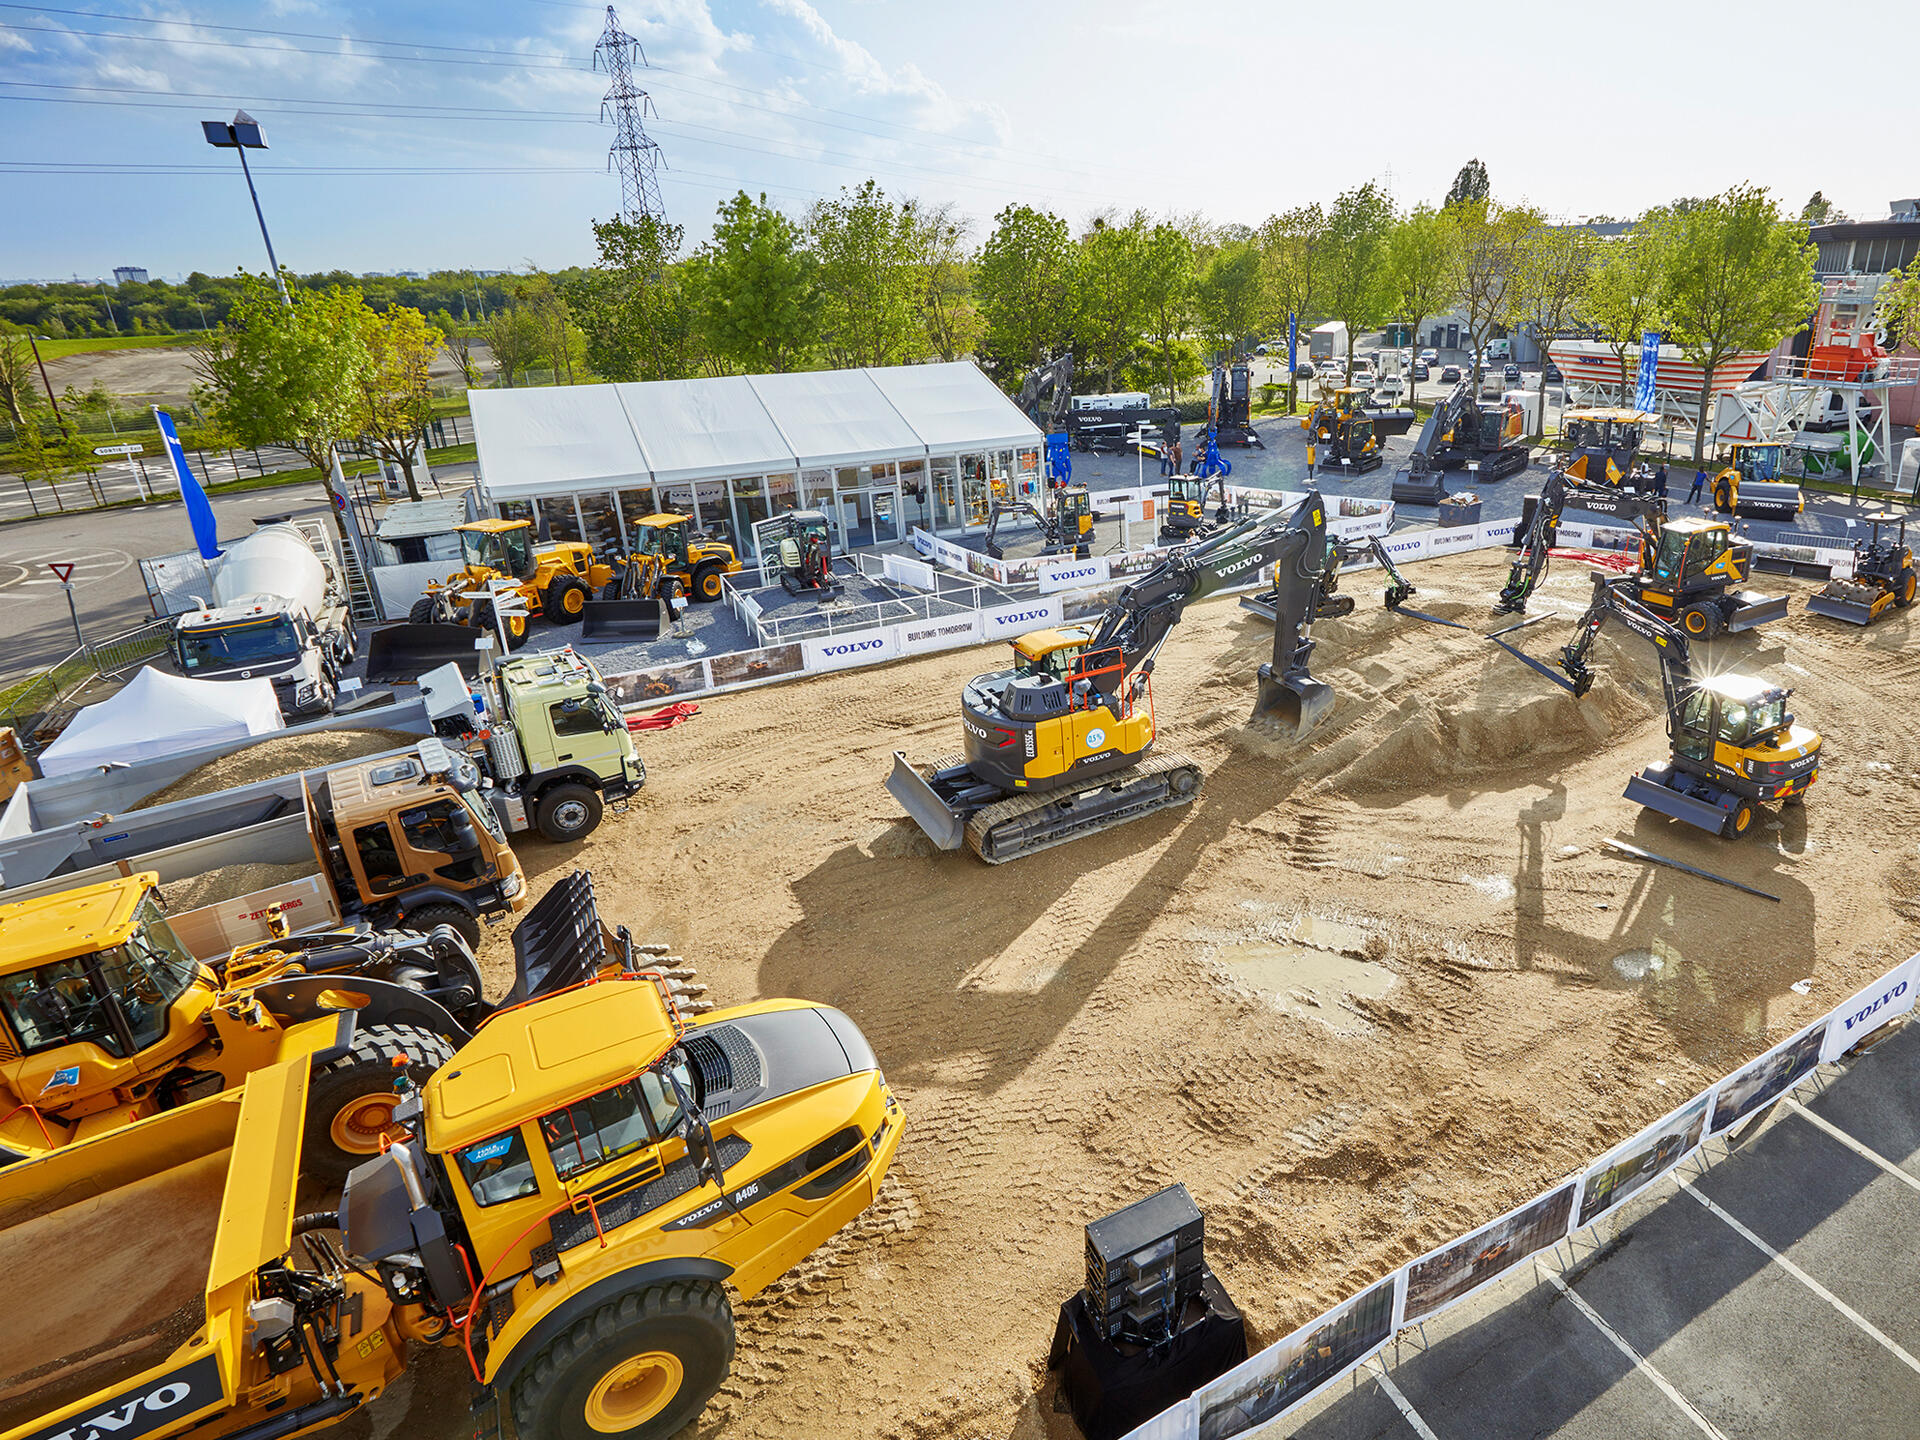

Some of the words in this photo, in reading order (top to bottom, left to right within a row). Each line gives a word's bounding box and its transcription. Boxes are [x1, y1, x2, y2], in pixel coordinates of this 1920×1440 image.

[1586, 501, 1617, 511] VOLVO
[1753, 501, 1783, 509] VOLVO
[1387, 541, 1421, 553] VOLVO
[1216, 552, 1263, 578] VOLVO
[1050, 567, 1097, 582] VOLVO
[994, 608, 1049, 625] VOLVO
[907, 628, 937, 642] BUILDING
[937, 621, 973, 637] TOMORROW
[1626, 619, 1652, 638] VOLVO
[822, 638, 884, 657] VOLVO
[1083, 752, 1111, 764] VOLVO
[1790, 755, 1816, 770] VOLVO
[1714, 763, 1736, 776] VOLVO
[1844, 981, 1908, 1031] VOLVO
[735, 1182, 759, 1204] A40G
[677, 1200, 723, 1226] VOLVO
